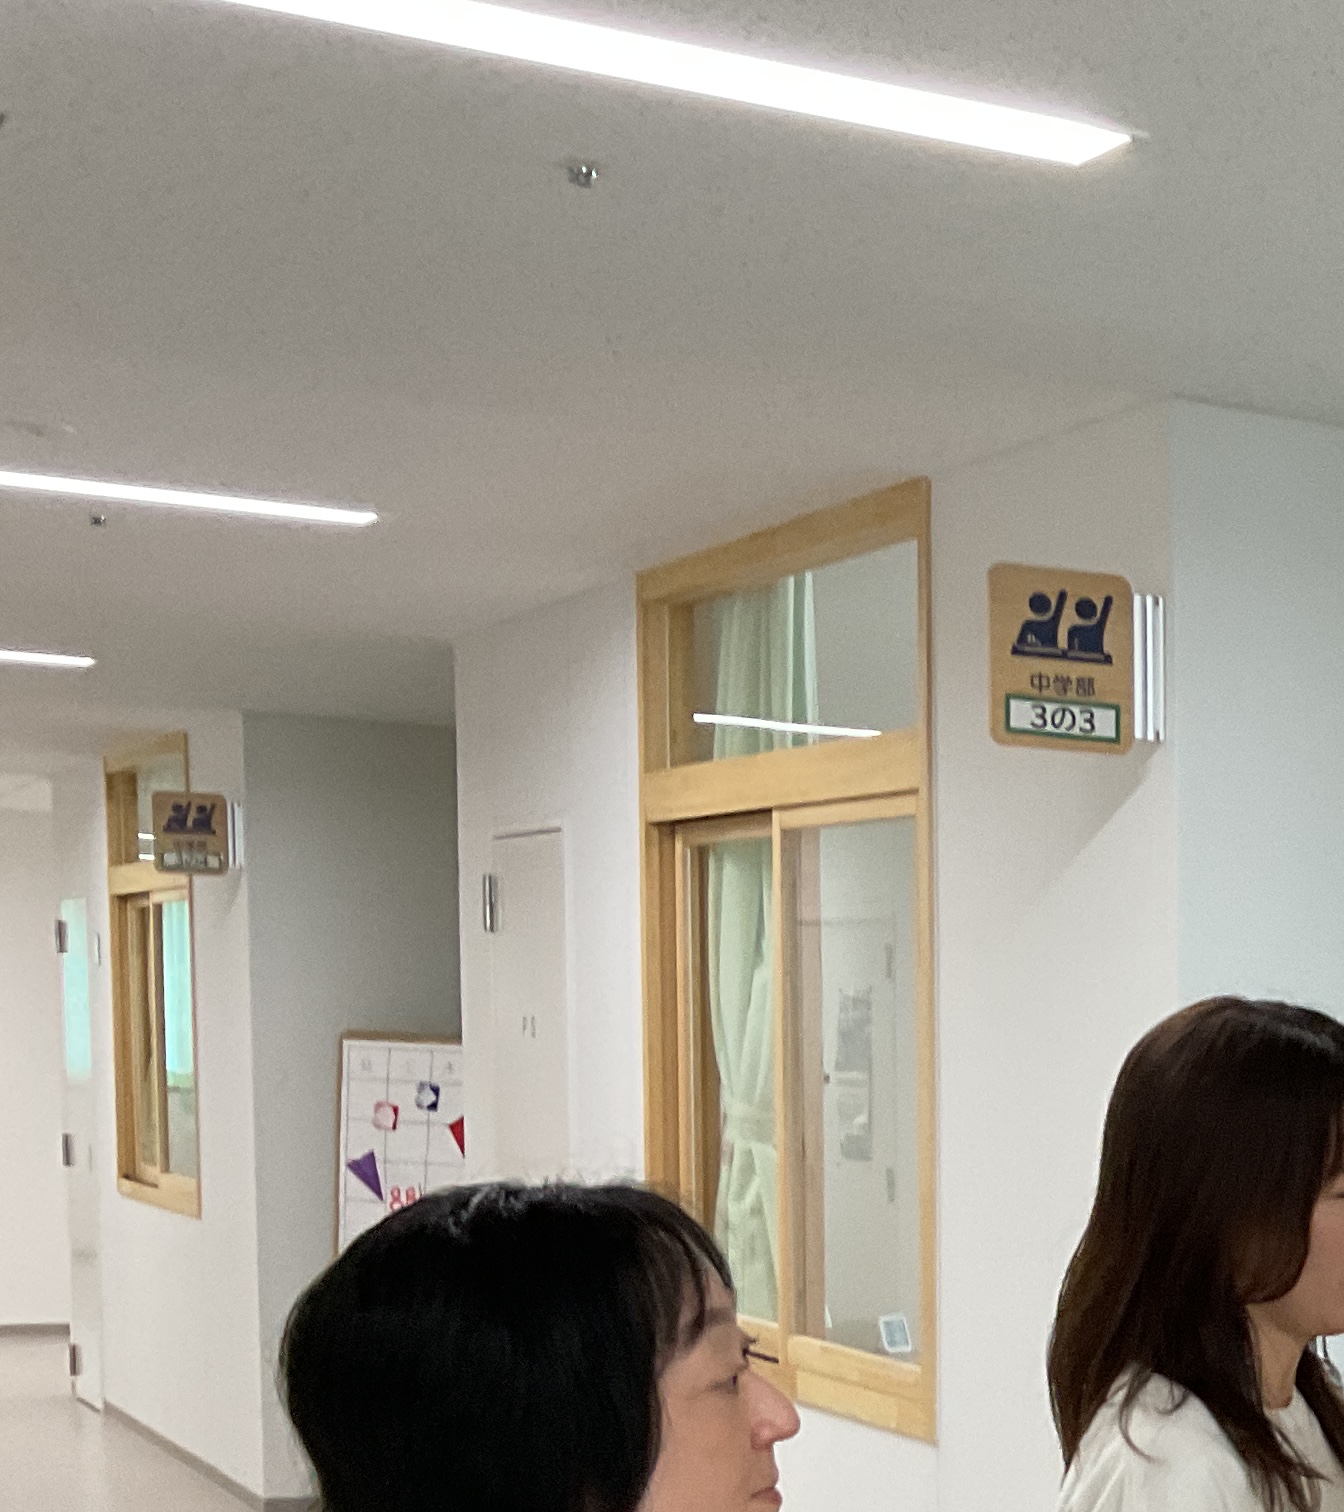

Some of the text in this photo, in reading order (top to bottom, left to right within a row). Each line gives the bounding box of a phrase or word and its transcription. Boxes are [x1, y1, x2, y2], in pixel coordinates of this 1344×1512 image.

[1030, 672, 1096, 697] 中学部
[1030, 703, 1096, 734] 3の3
